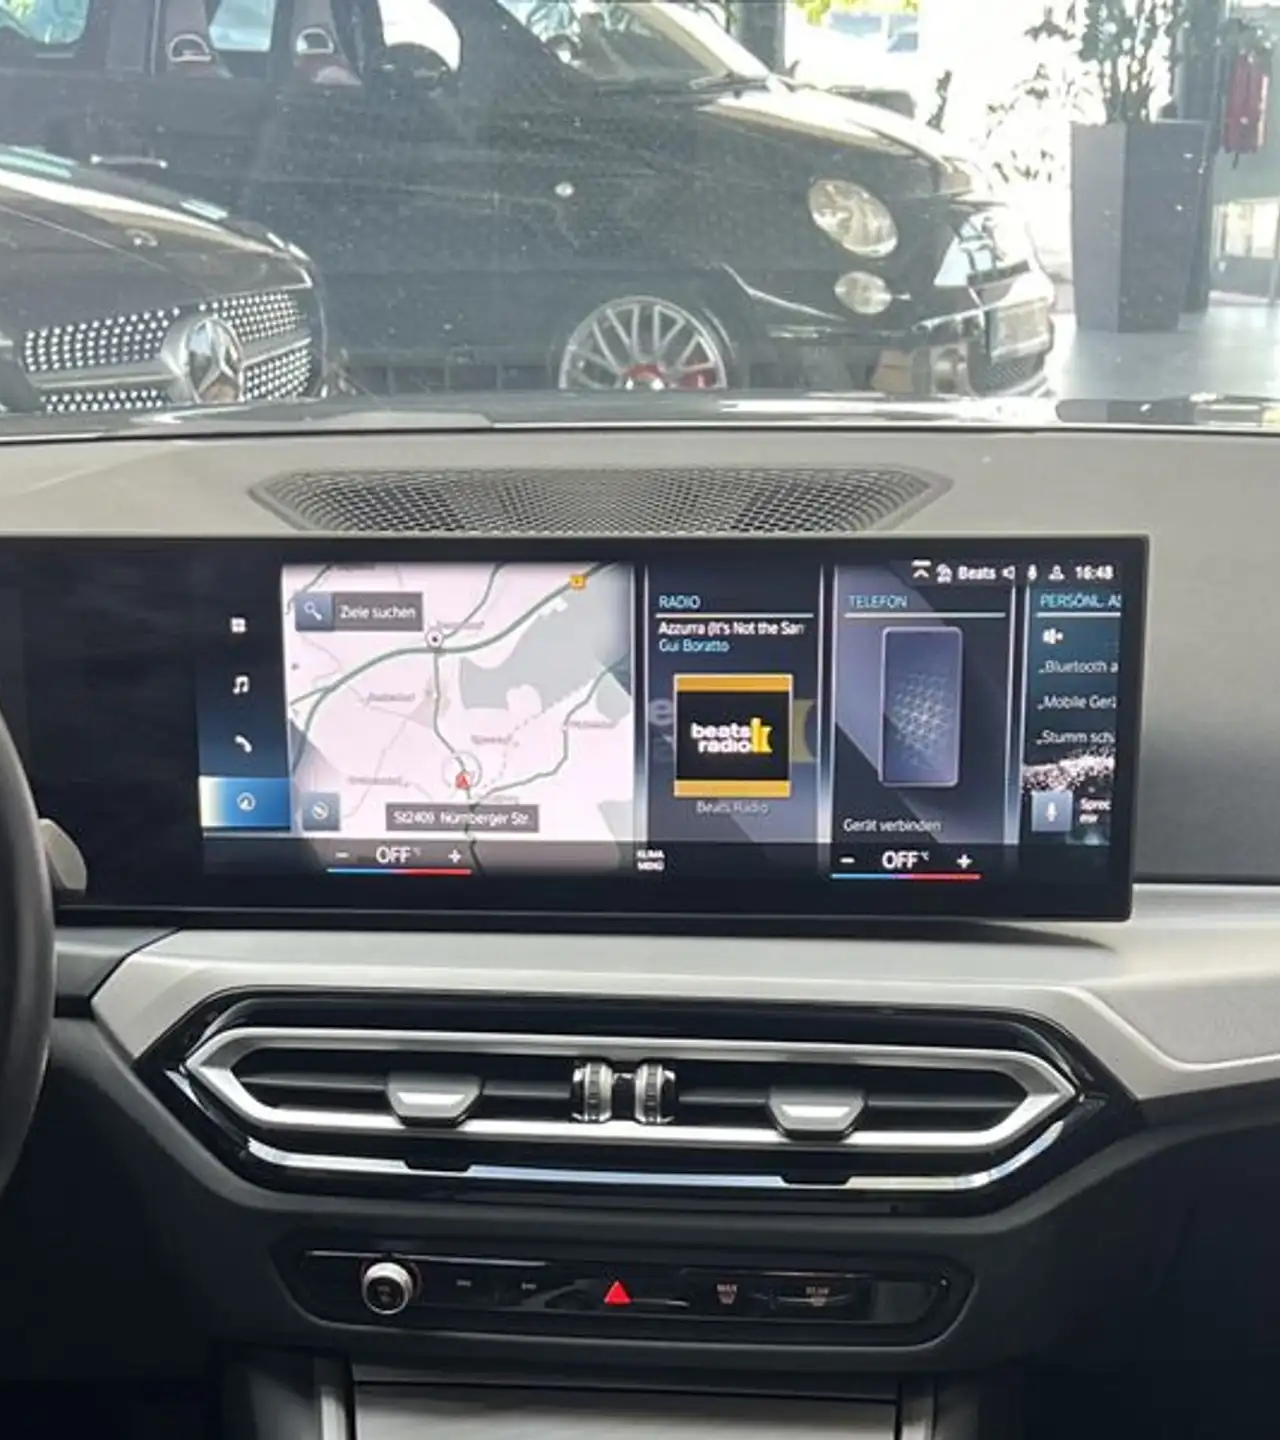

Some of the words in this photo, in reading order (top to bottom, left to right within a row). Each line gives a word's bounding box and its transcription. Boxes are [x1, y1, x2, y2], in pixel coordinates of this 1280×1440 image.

[957, 566, 997, 580] Beats
[1074, 565, 1114, 580] 16:48
[658, 595, 701, 609] RADIO
[848, 594, 908, 609] TELEFON
[340, 604, 370, 619] Ziele
[372, 604, 417, 619] suchen
[657, 621, 706, 635] Azzurra
[733, 621, 756, 635] Not
[757, 621, 779, 635] the
[658, 638, 680, 652] Gui
[683, 638, 730, 652] Boratto
[690, 721, 752, 739] beats
[697, 738, 753, 754] radio
[439, 811, 510, 827] Nürnberger
[843, 817, 877, 832] Gerät
[879, 817, 942, 832] verbinden
[375, 846, 411, 865] OFF
[881, 851, 918, 870] OFF
